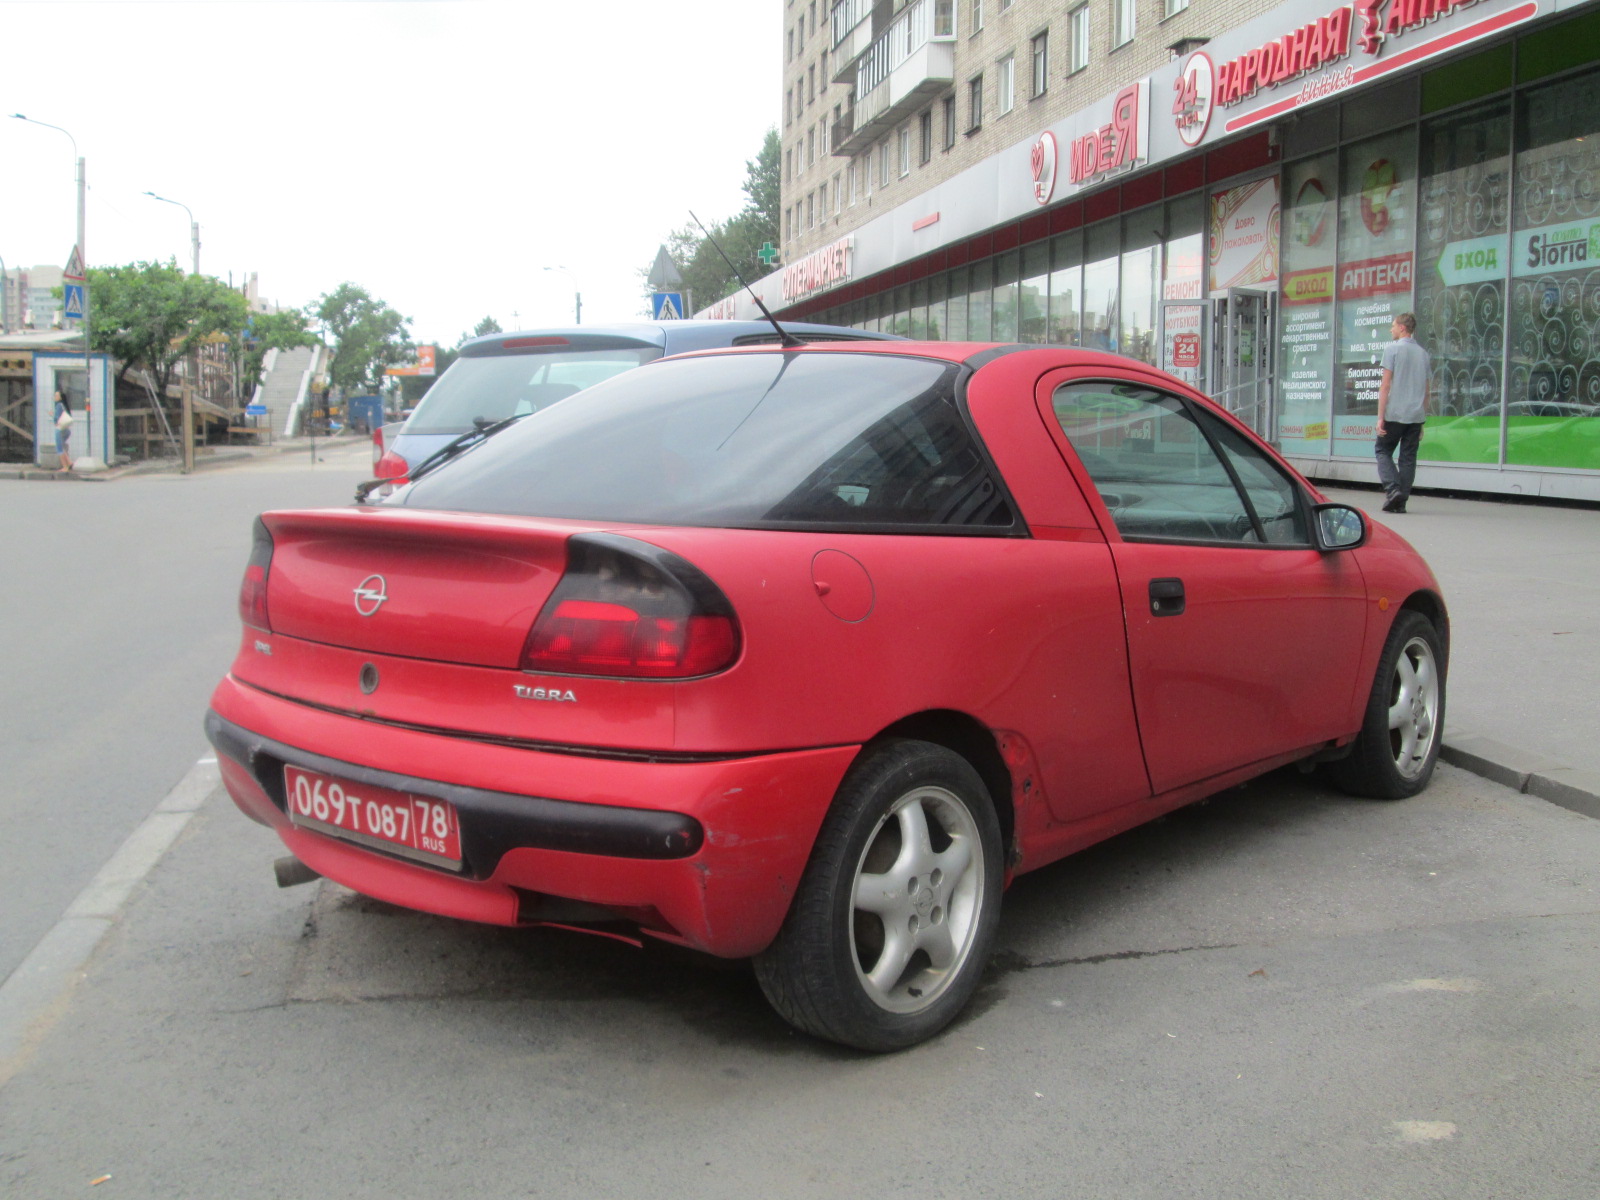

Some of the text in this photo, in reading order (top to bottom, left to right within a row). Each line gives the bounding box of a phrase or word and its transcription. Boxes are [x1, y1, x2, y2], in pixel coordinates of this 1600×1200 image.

[1215, 7, 1353, 107] НАРОДНАЯ
[1172, 69, 1198, 115] 24
[1527, 232, 1588, 268] Storia
[782, 238, 851, 302] СУПЕРМАРКЕТ
[1342, 260, 1411, 291] АПТЕКА
[1165, 279, 1201, 300] РЕМОНТ
[1295, 276, 1328, 296] ВХОД
[1356, 302, 1391, 315] лечебная
[1291, 309, 1320, 322] широкий
[1354, 314, 1393, 327] косметика
[1286, 321, 1326, 333] ассортимент
[1281, 332, 1329, 344] лекарственных
[1178, 343, 1196, 354] 24
[1292, 343, 1318, 354] средств
[1350, 343, 1366, 352] мед.
[1291, 370, 1318, 380] изделия
[1348, 367, 1384, 378] биологиче
[1282, 380, 1327, 391] медицинского
[1354, 380, 1382, 389] активн
[1285, 391, 1322, 401] назначения
[1356, 389, 1380, 400] добав
[513, 684, 577, 702] TIGRA
[415, 801, 448, 838] 78
[422, 836, 446, 853] RUS
